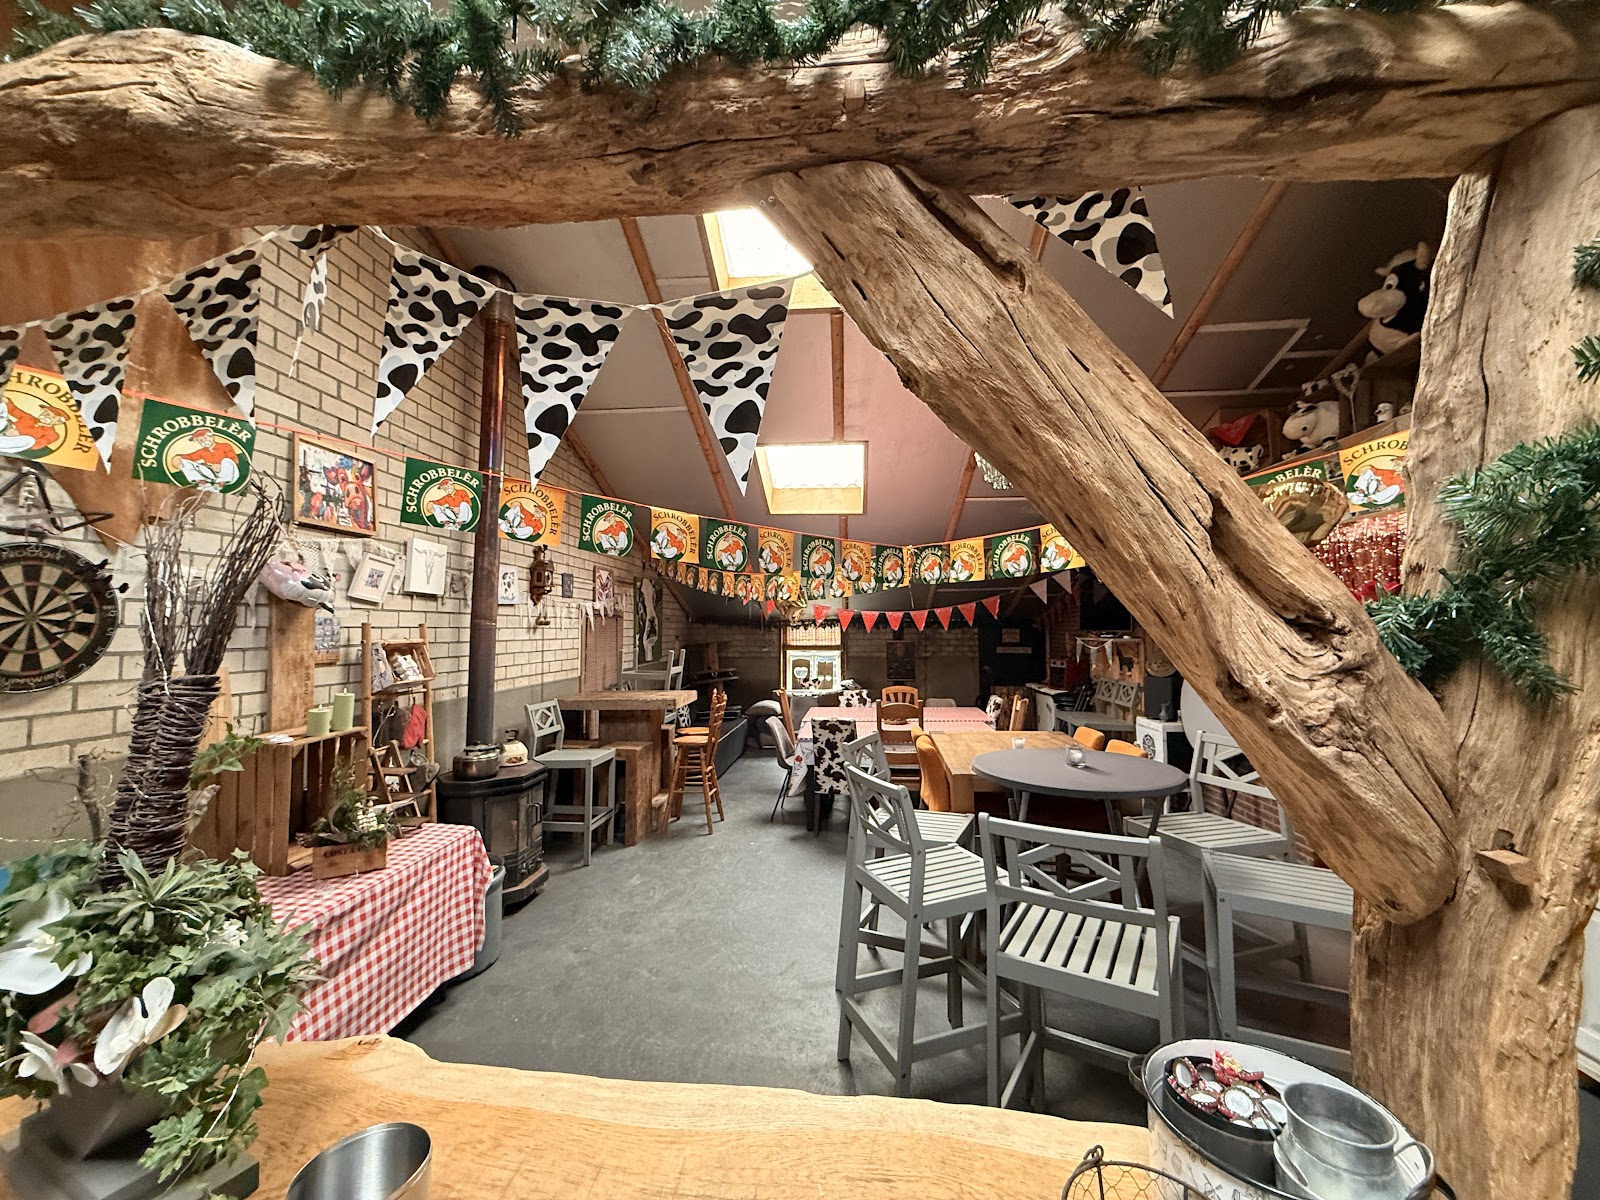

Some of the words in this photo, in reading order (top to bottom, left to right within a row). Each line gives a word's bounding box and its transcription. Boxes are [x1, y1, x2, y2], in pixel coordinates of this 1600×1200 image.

[140, 414, 252, 468] SCHROBBELÈR
[406, 467, 480, 513] SCHROBBELÈR
[582, 502, 633, 541] SCHROBBELÈR
[706, 524, 747, 560] SCHROBBELÈR
